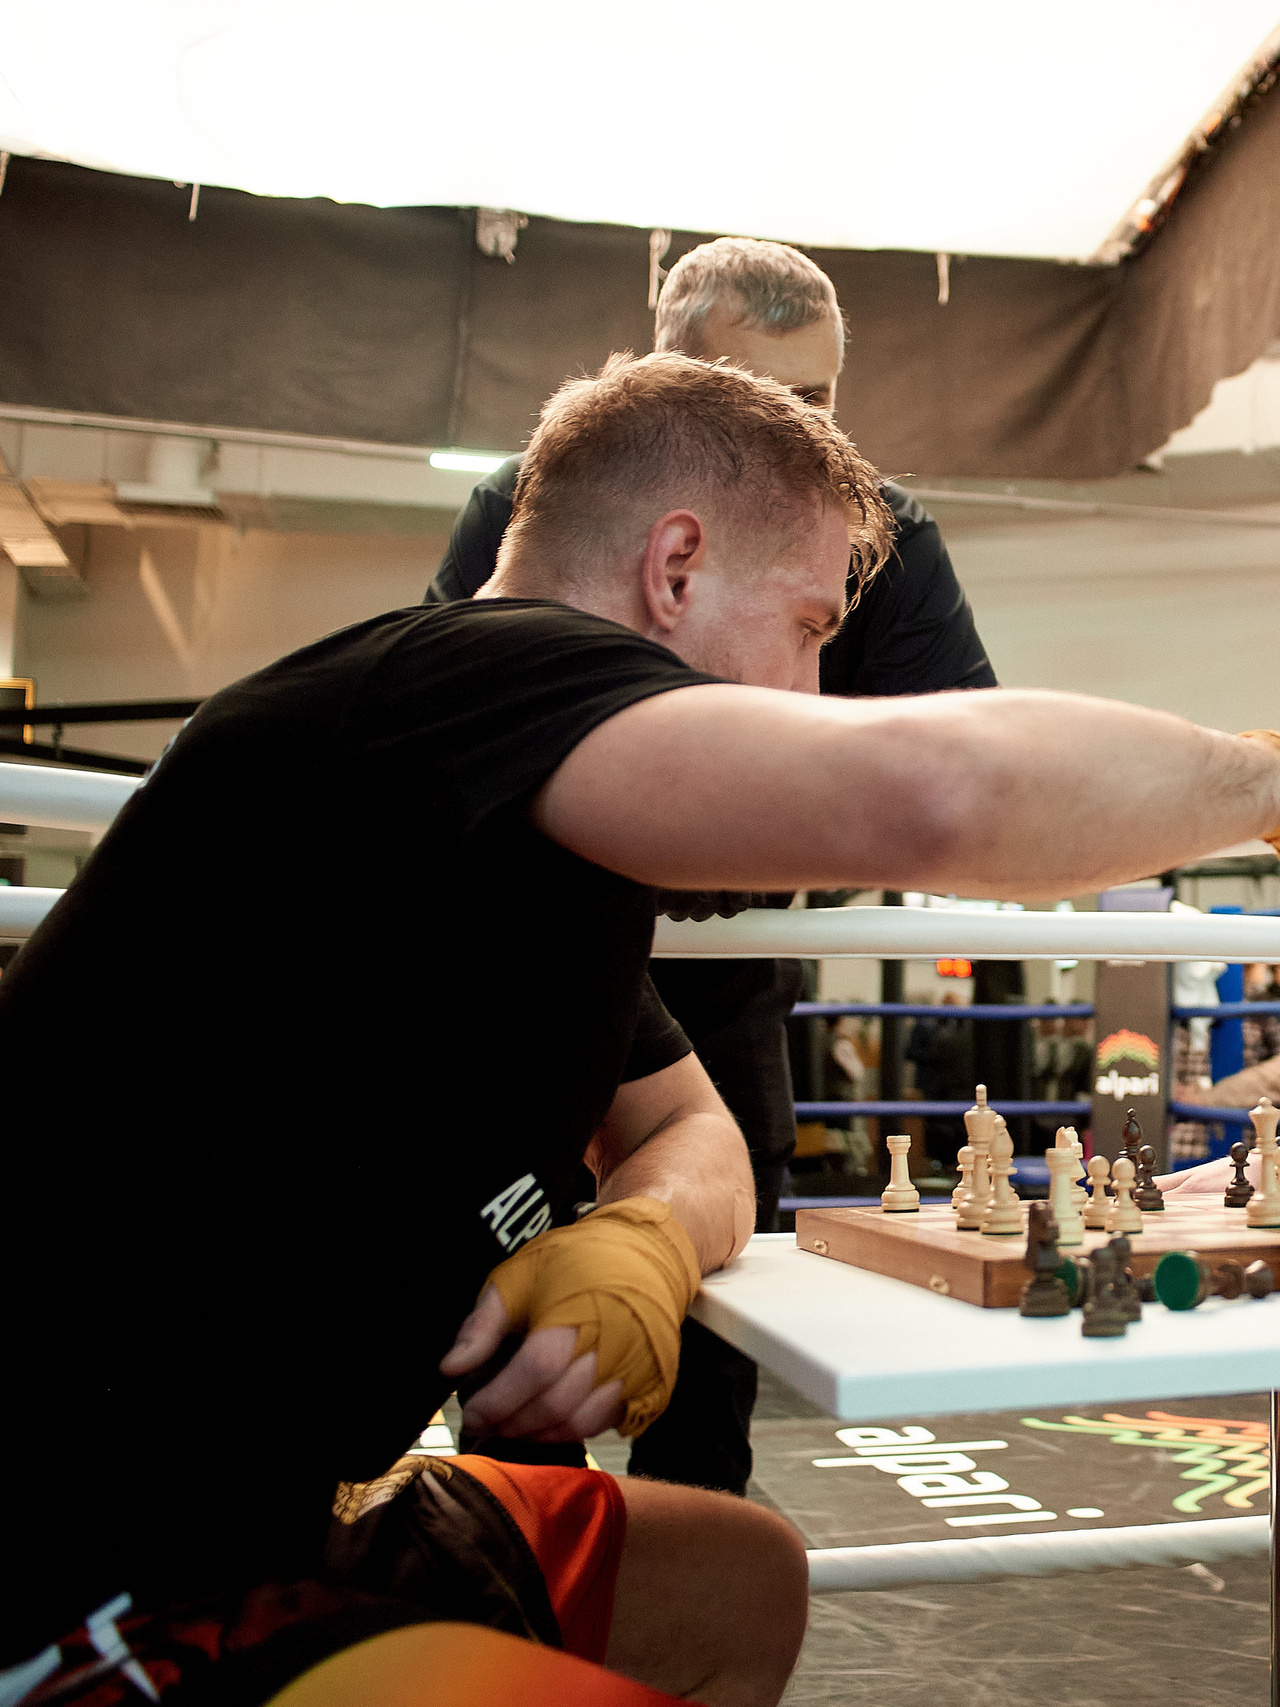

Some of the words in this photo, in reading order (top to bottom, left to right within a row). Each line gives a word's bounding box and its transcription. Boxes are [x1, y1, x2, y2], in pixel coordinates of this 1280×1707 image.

[1095, 1070, 1159, 1101] alpari
[480, 1172, 553, 1253] ALP
[811, 1426, 1105, 1527] alpari
